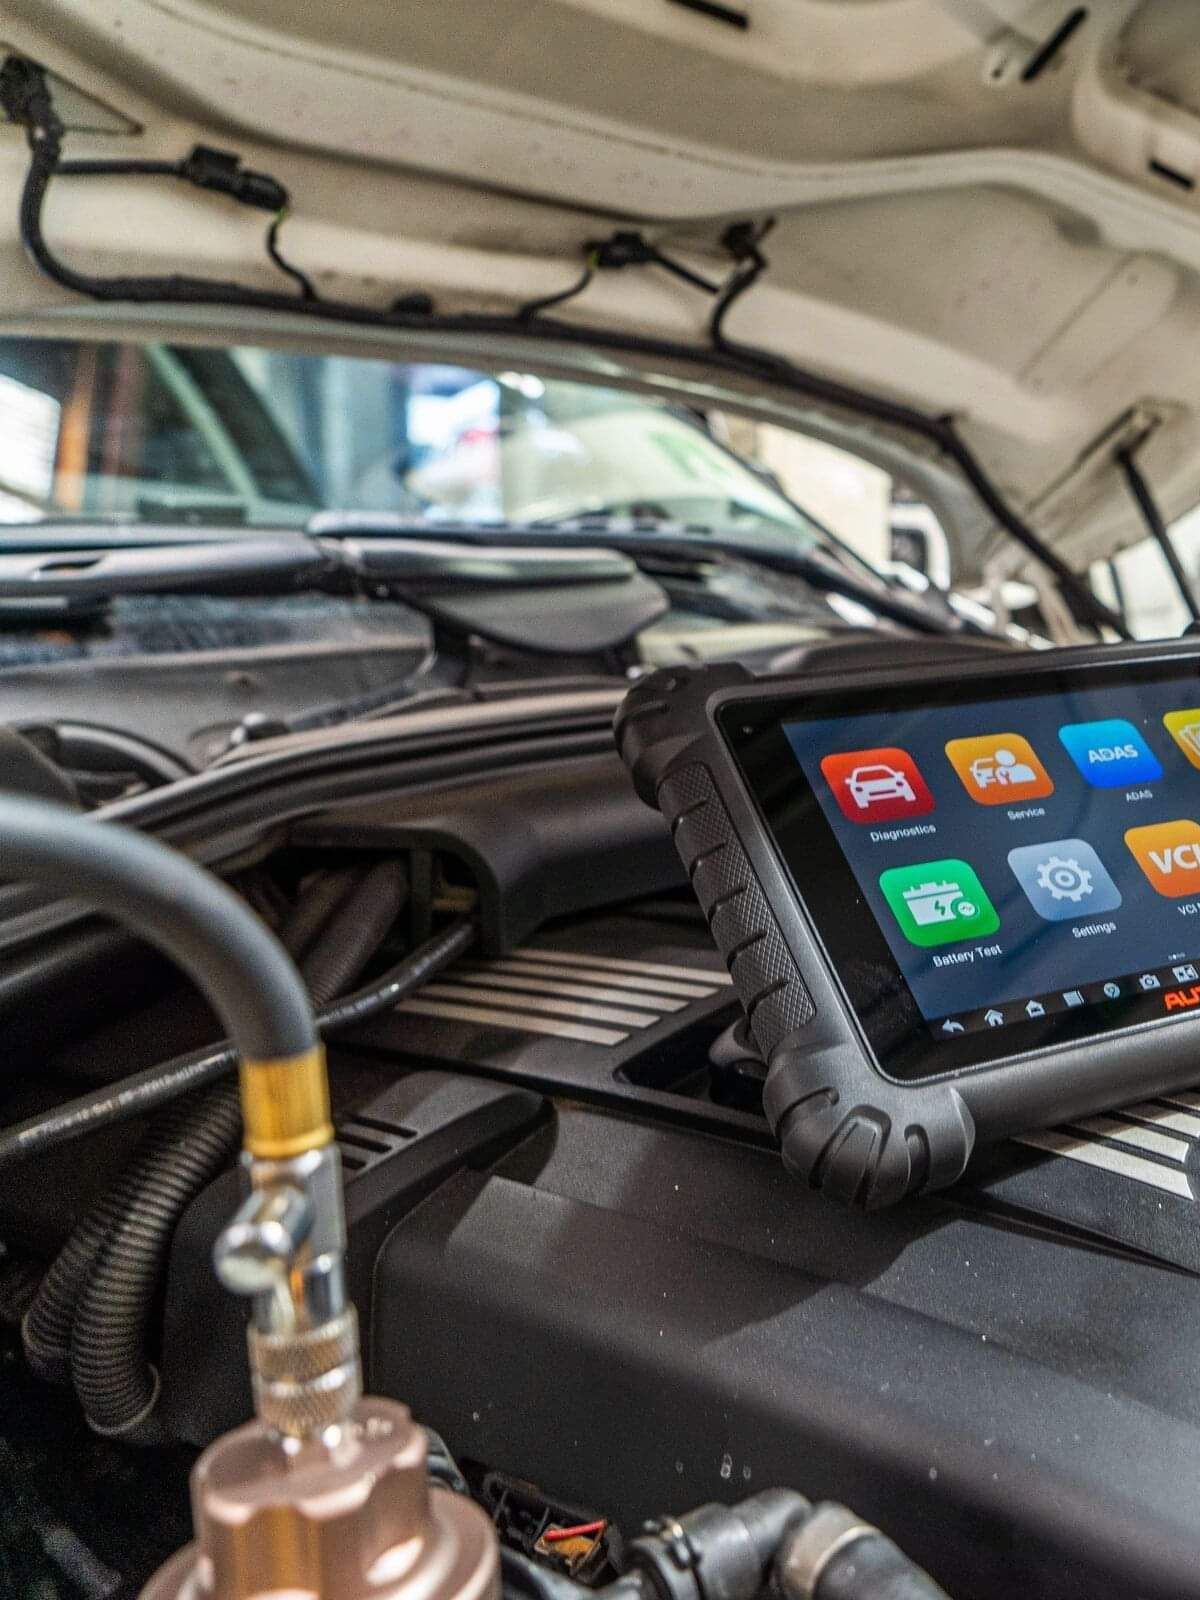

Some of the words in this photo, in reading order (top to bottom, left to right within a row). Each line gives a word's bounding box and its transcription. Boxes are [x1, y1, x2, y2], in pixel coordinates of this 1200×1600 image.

[1088, 744, 1138, 764] ADAS
[1125, 790, 1153, 802] ADAS
[1007, 806, 1045, 821] Service
[870, 823, 937, 843] Diagnostics
[1178, 904, 1197, 916] VCI
[1072, 921, 1117, 938] Settings
[932, 946, 975, 969] Battery
[976, 942, 1003, 959] Test
